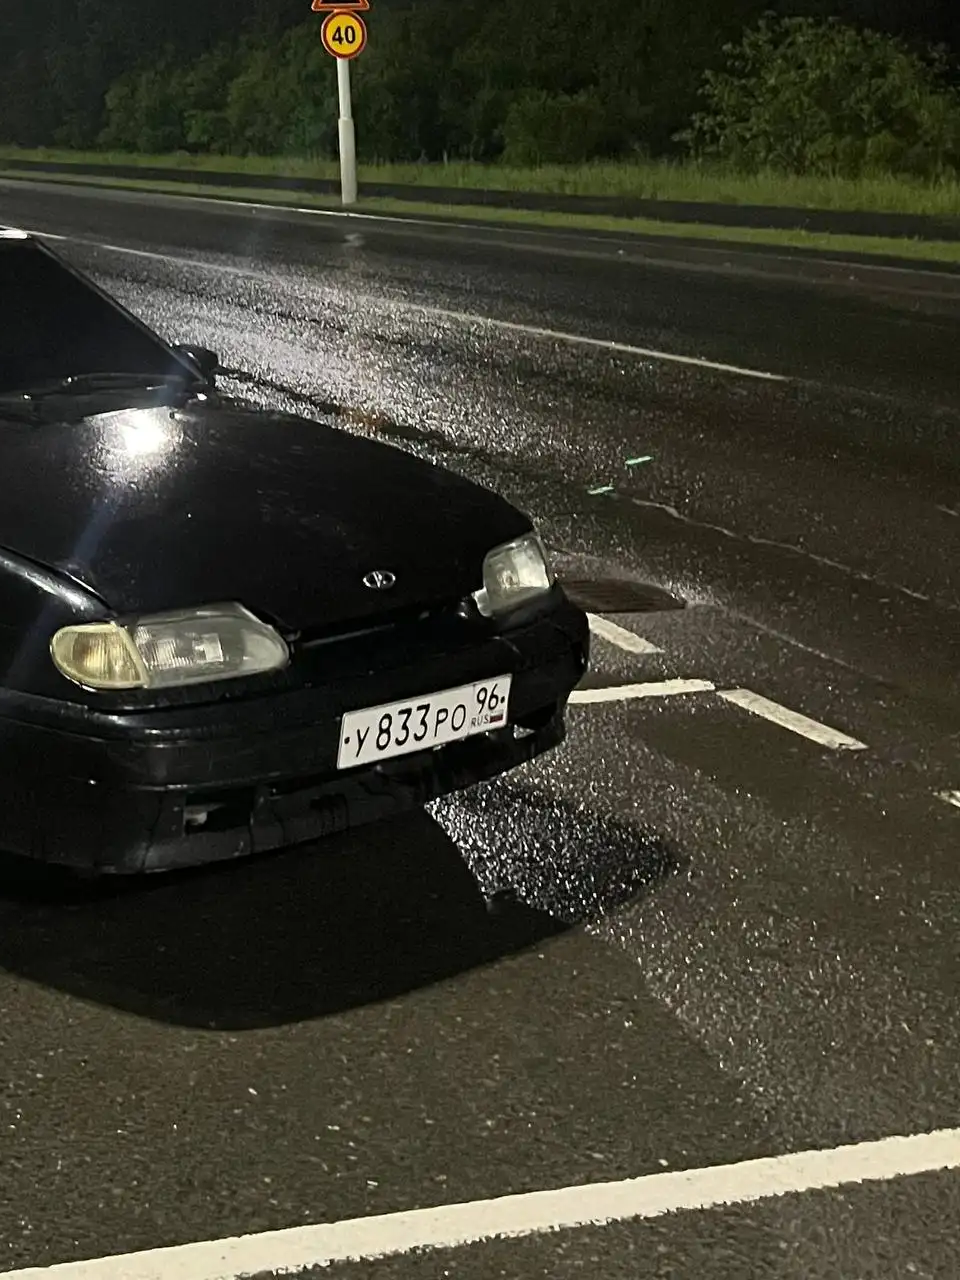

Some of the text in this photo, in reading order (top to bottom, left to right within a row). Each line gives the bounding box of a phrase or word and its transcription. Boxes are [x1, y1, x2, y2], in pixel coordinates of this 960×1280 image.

[332, 25, 356, 45] 40
[476, 683, 499, 715] 96
[470, 714, 491, 729] RUS
